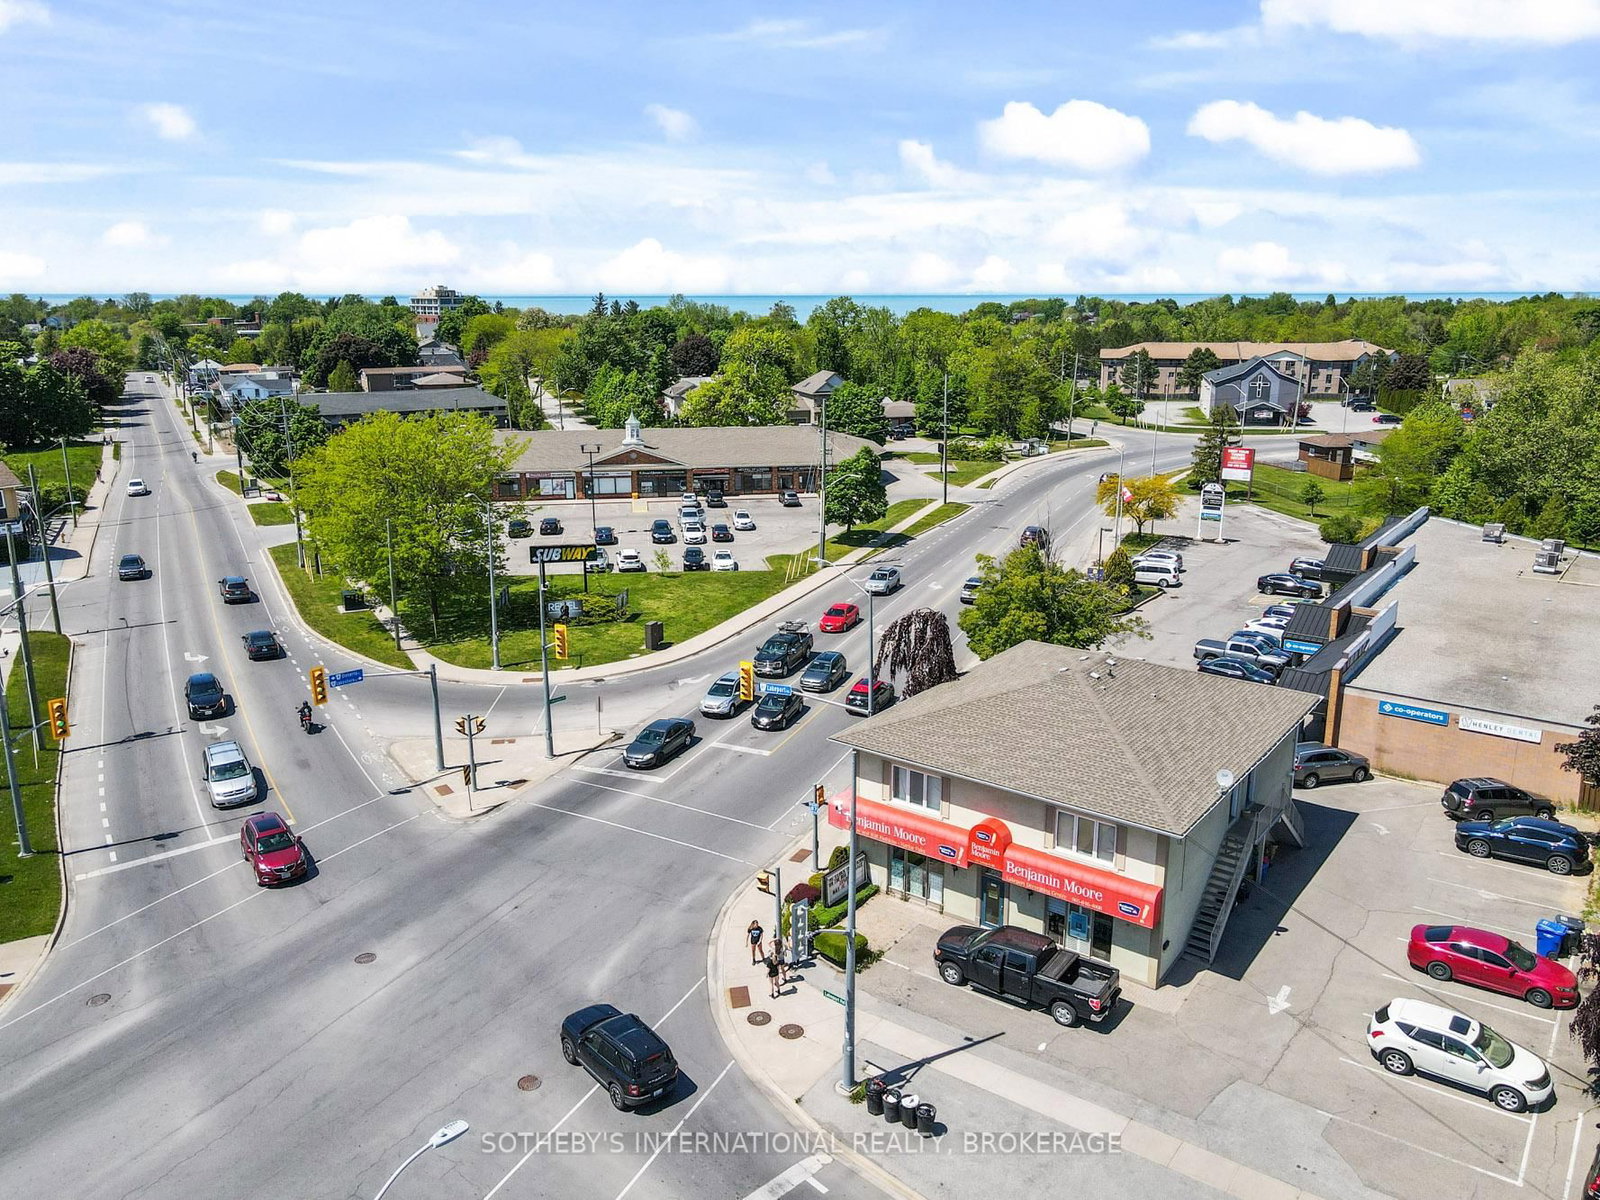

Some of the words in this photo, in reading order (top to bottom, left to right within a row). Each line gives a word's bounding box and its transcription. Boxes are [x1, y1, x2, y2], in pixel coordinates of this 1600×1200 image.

[532, 546, 595, 562] SUBWAY
[1394, 707, 1444, 720] co-operators
[1472, 721, 1504, 732] HENLEY
[1507, 727, 1538, 739] DENTAL
[893, 825, 927, 846] Moore
[971, 841, 1000, 857] Benjamin
[971, 850, 991, 861] Moore
[1006, 860, 1060, 888] Benjamin
[1063, 878, 1103, 902] Moore
